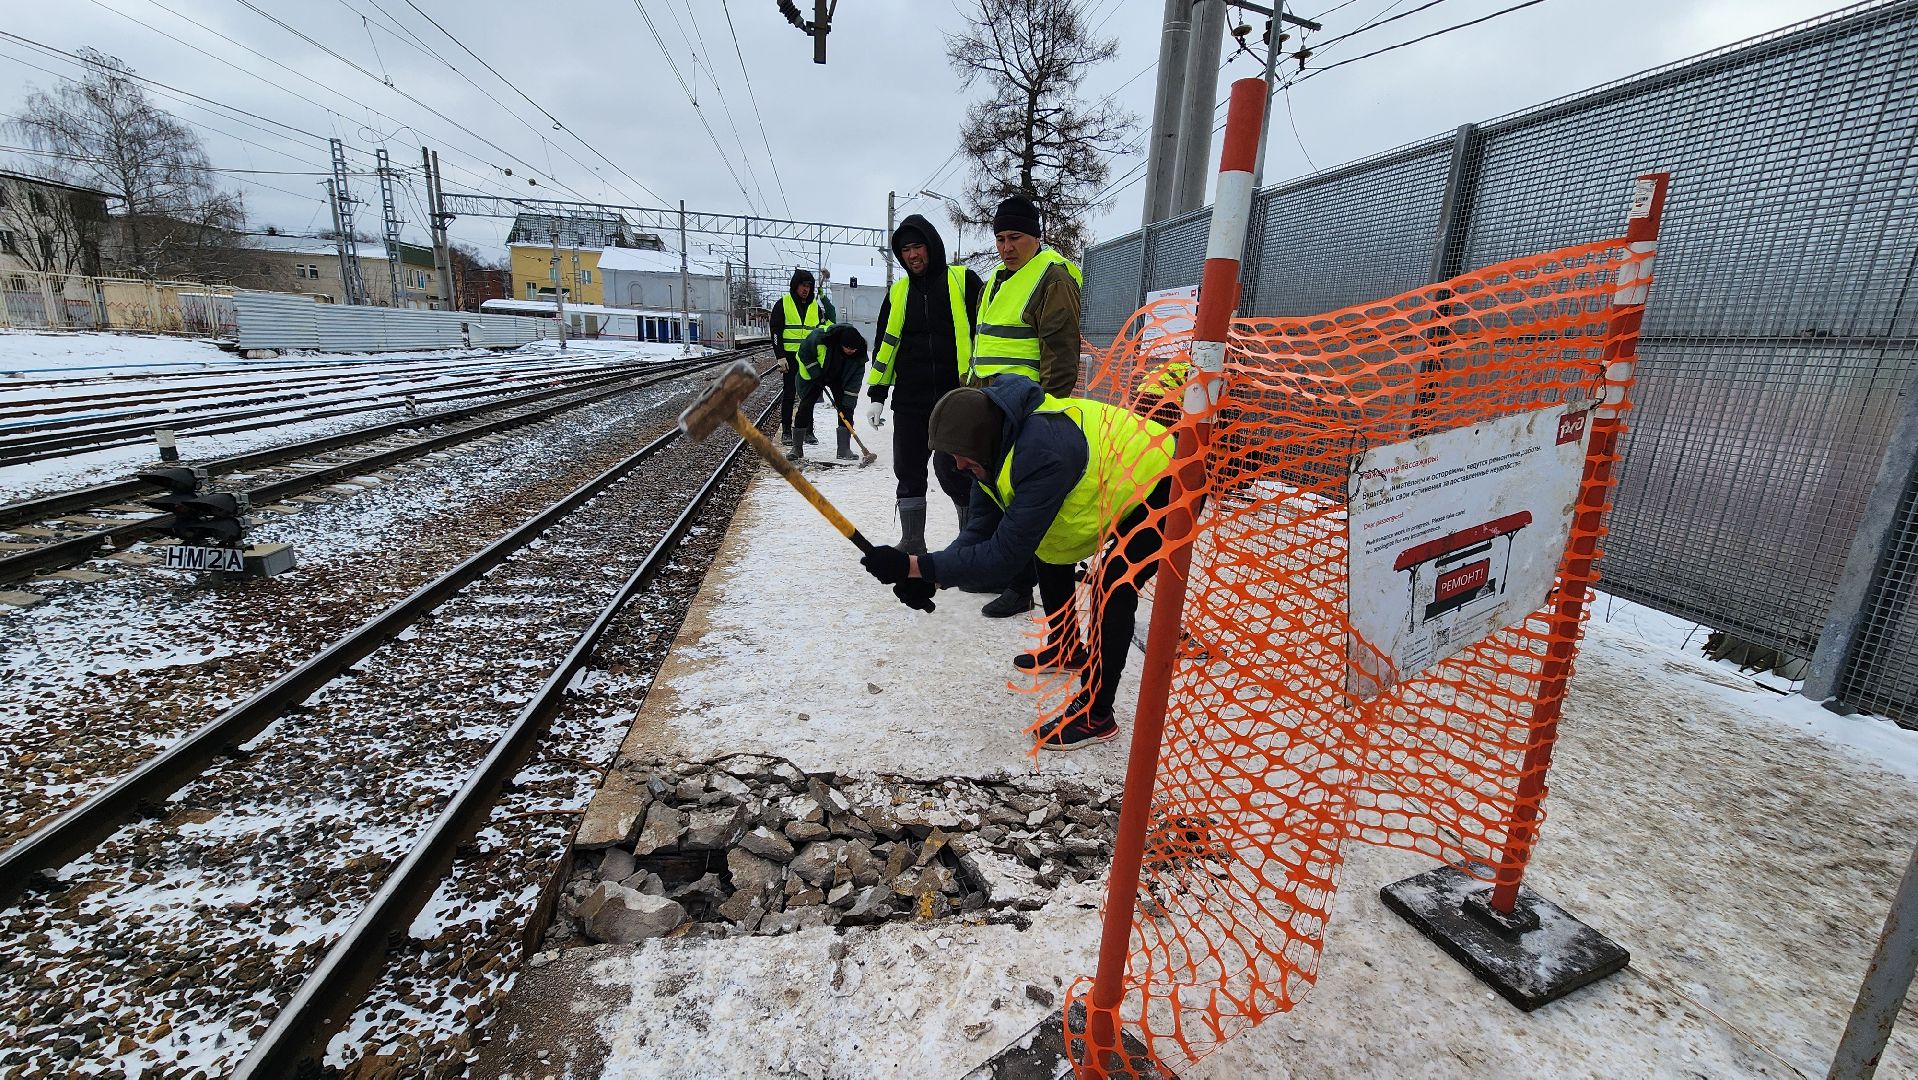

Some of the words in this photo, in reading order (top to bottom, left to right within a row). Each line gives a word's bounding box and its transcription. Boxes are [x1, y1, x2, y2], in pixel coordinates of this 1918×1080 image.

[1388, 476, 1425, 492] нимательны
[1467, 459, 1488, 470] ведутся
[1488, 451, 1520, 466] ремонтные
[1395, 491, 1410, 501] свои
[1450, 468, 1489, 486] доставленные
[1363, 521, 1375, 530] Dear
[1394, 528, 1406, 537] work
[1431, 515, 1446, 524] Please
[168, 546, 242, 570] НМ2А
[1441, 568, 1484, 592] РЕМОНТ!
